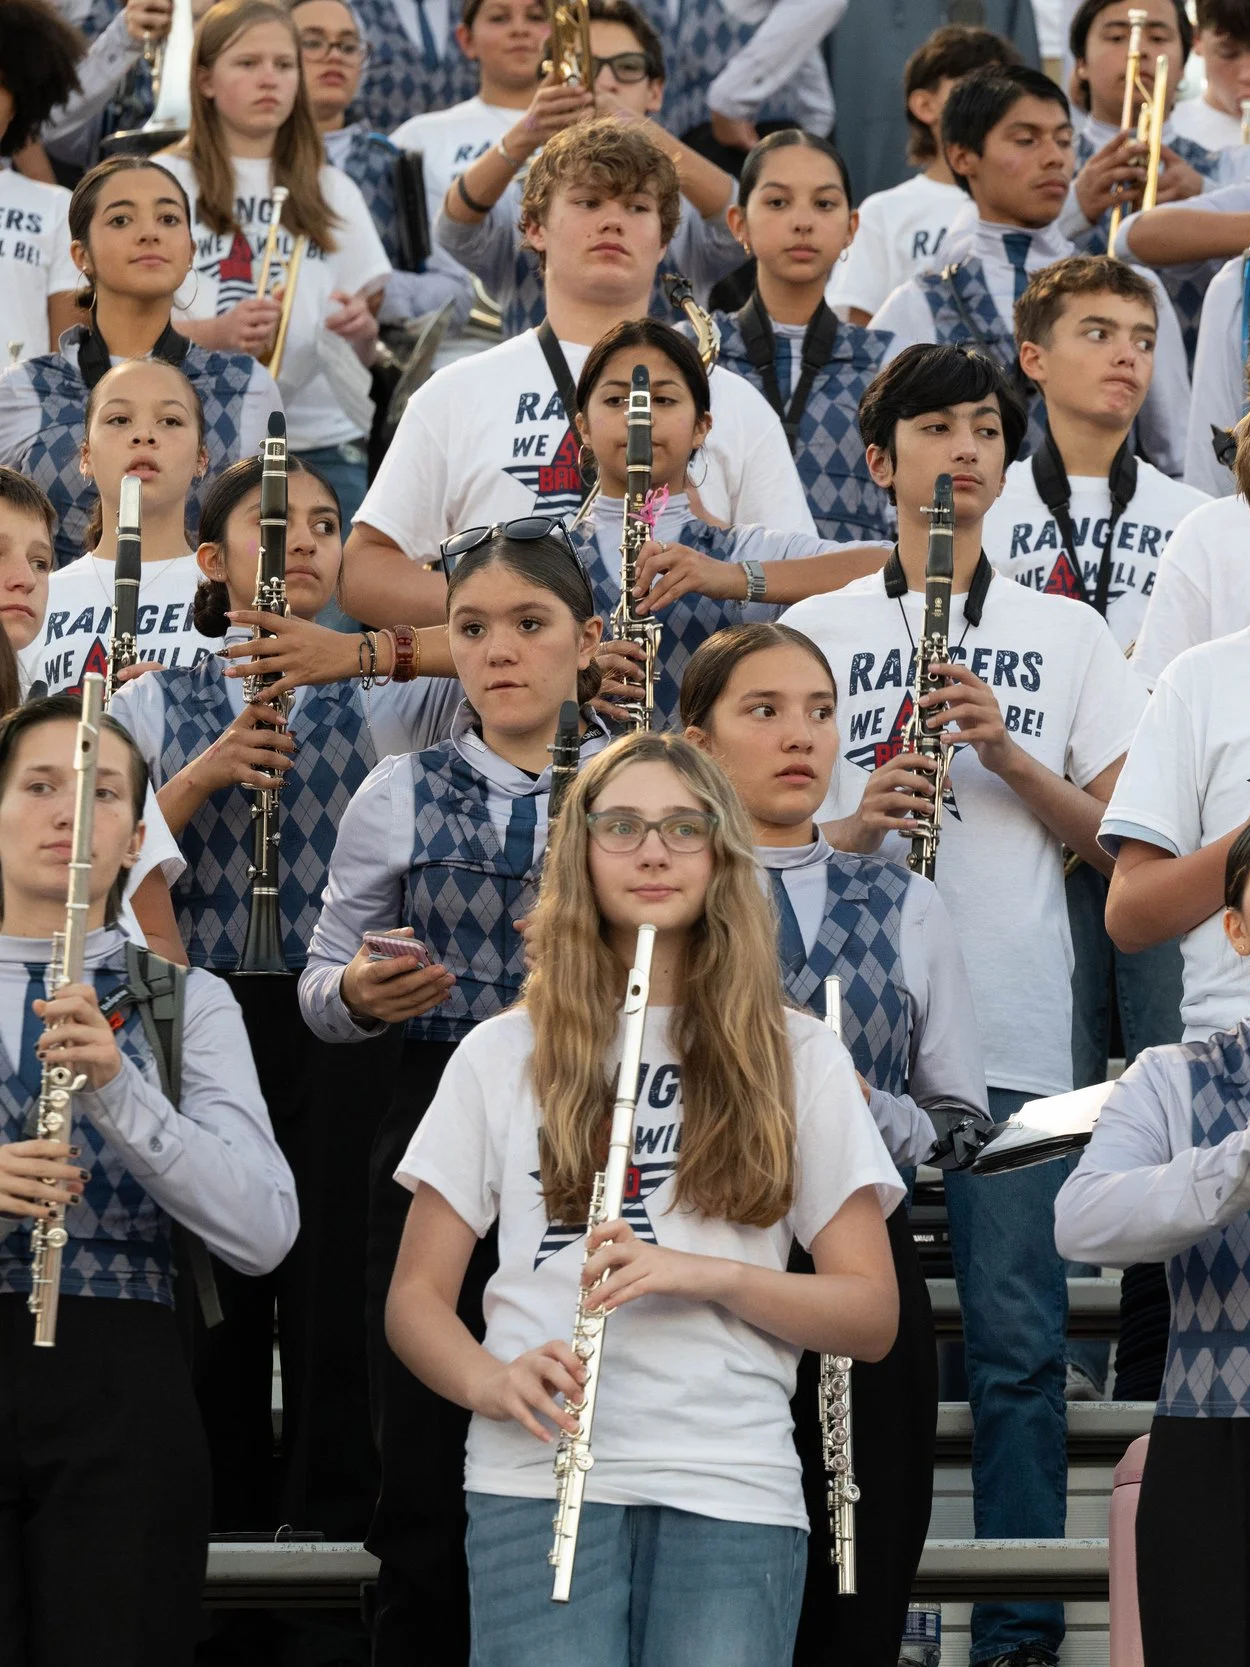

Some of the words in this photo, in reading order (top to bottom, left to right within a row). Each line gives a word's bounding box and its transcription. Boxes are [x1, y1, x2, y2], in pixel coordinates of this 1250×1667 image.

[512, 434, 549, 458] WE
[1016, 566, 1045, 592] WE
[45, 650, 75, 687] WE
[850, 707, 885, 742] WE
[1005, 705, 1045, 738] BE!
